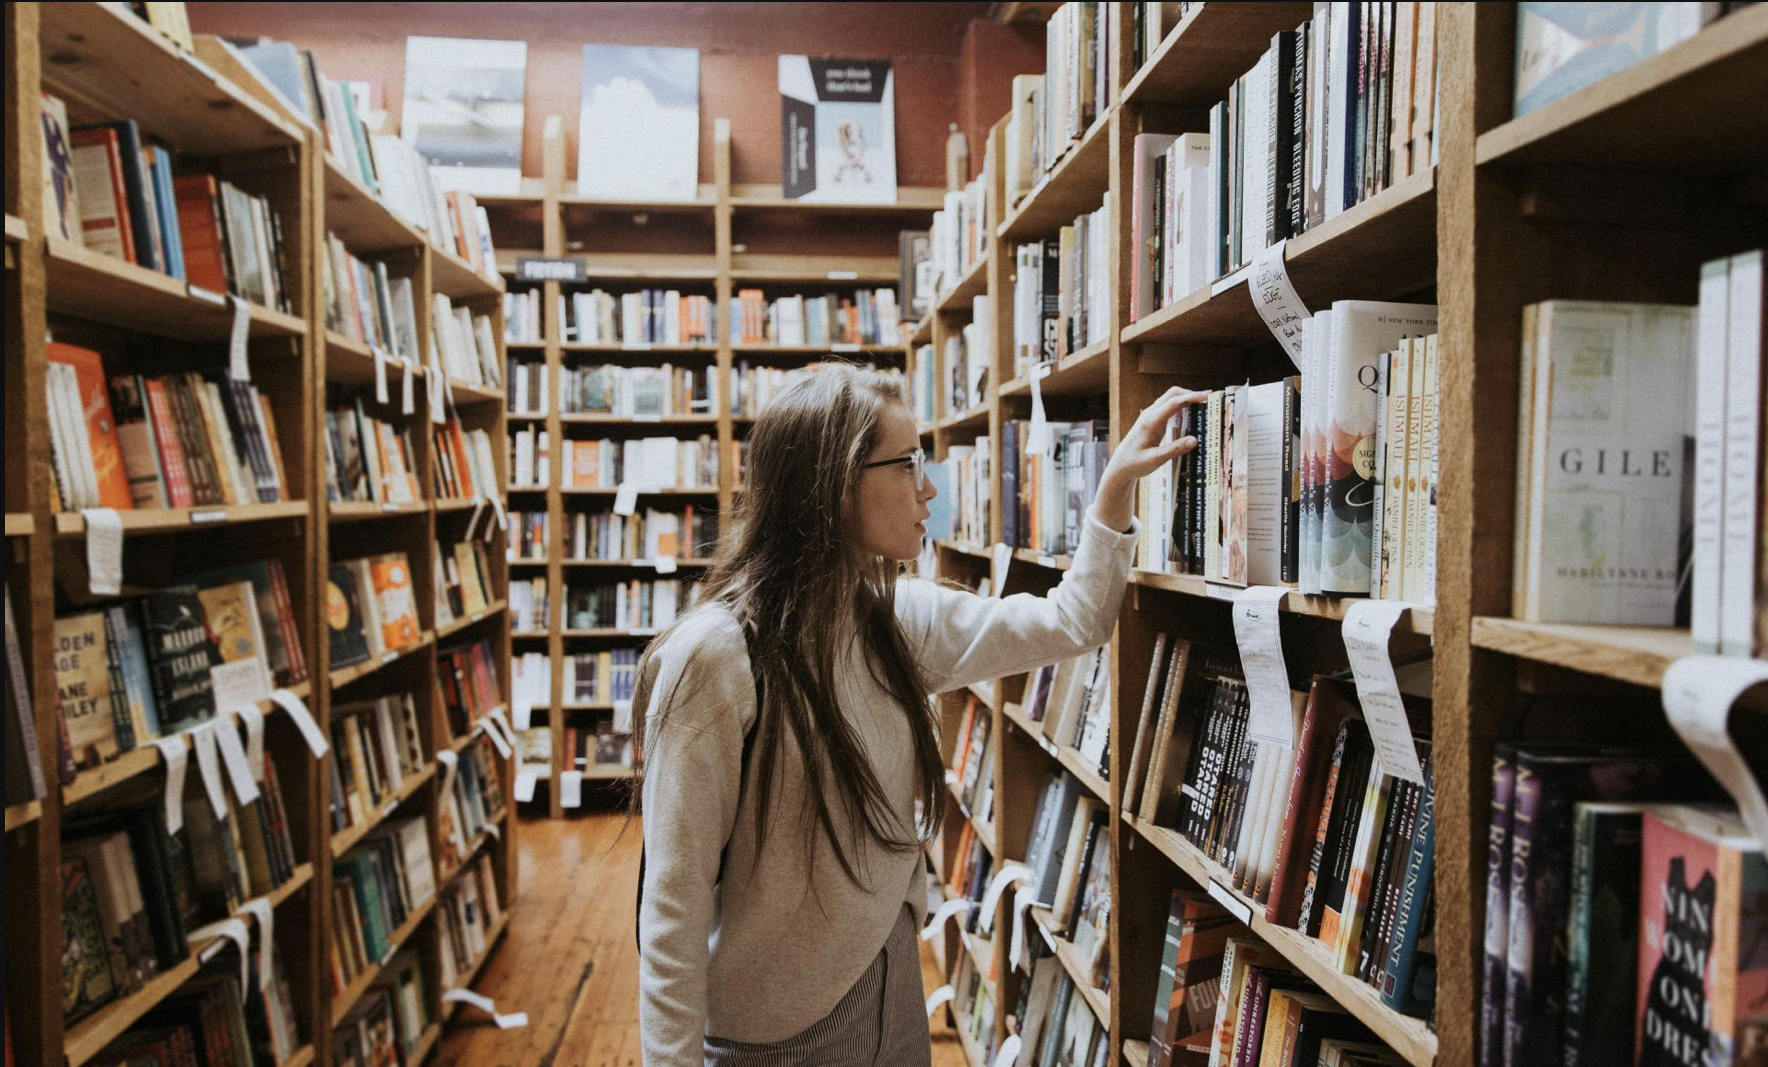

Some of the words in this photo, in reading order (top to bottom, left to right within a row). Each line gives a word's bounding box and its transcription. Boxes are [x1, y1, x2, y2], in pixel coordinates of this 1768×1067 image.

[1294, 36, 1304, 82] THOMAS
[1293, 83, 1303, 135] PYNCHON
[1291, 142, 1302, 196] BLEEDING
[1291, 199, 1301, 226] EDGE
[1394, 395, 1405, 459] ISHMAEL
[1409, 396, 1420, 461] ISHMAEL
[1422, 394, 1433, 460] ISHMAEL
[1391, 496, 1399, 529] DANIEL
[1419, 499, 1427, 533] DANIEL
[1390, 532, 1398, 565] QUINN
[1418, 536, 1426, 570] QUINN
[1197, 749, 1216, 816] OTARED
[1203, 752, 1222, 821] OTARED
[1492, 757, 1507, 783] M
[1515, 766, 1533, 793] M
[1404, 787, 1412, 805] WHY
[1411, 790, 1420, 809] WHY
[1397, 814, 1407, 836] CAME
[1404, 818, 1414, 840] CAME
[1370, 861, 1386, 923] CROCODILES
[1510, 835, 1531, 906] ROSE
[1389, 849, 1424, 968] PUNISHMENT
[1245, 996, 1260, 1063] UNRESTORED
